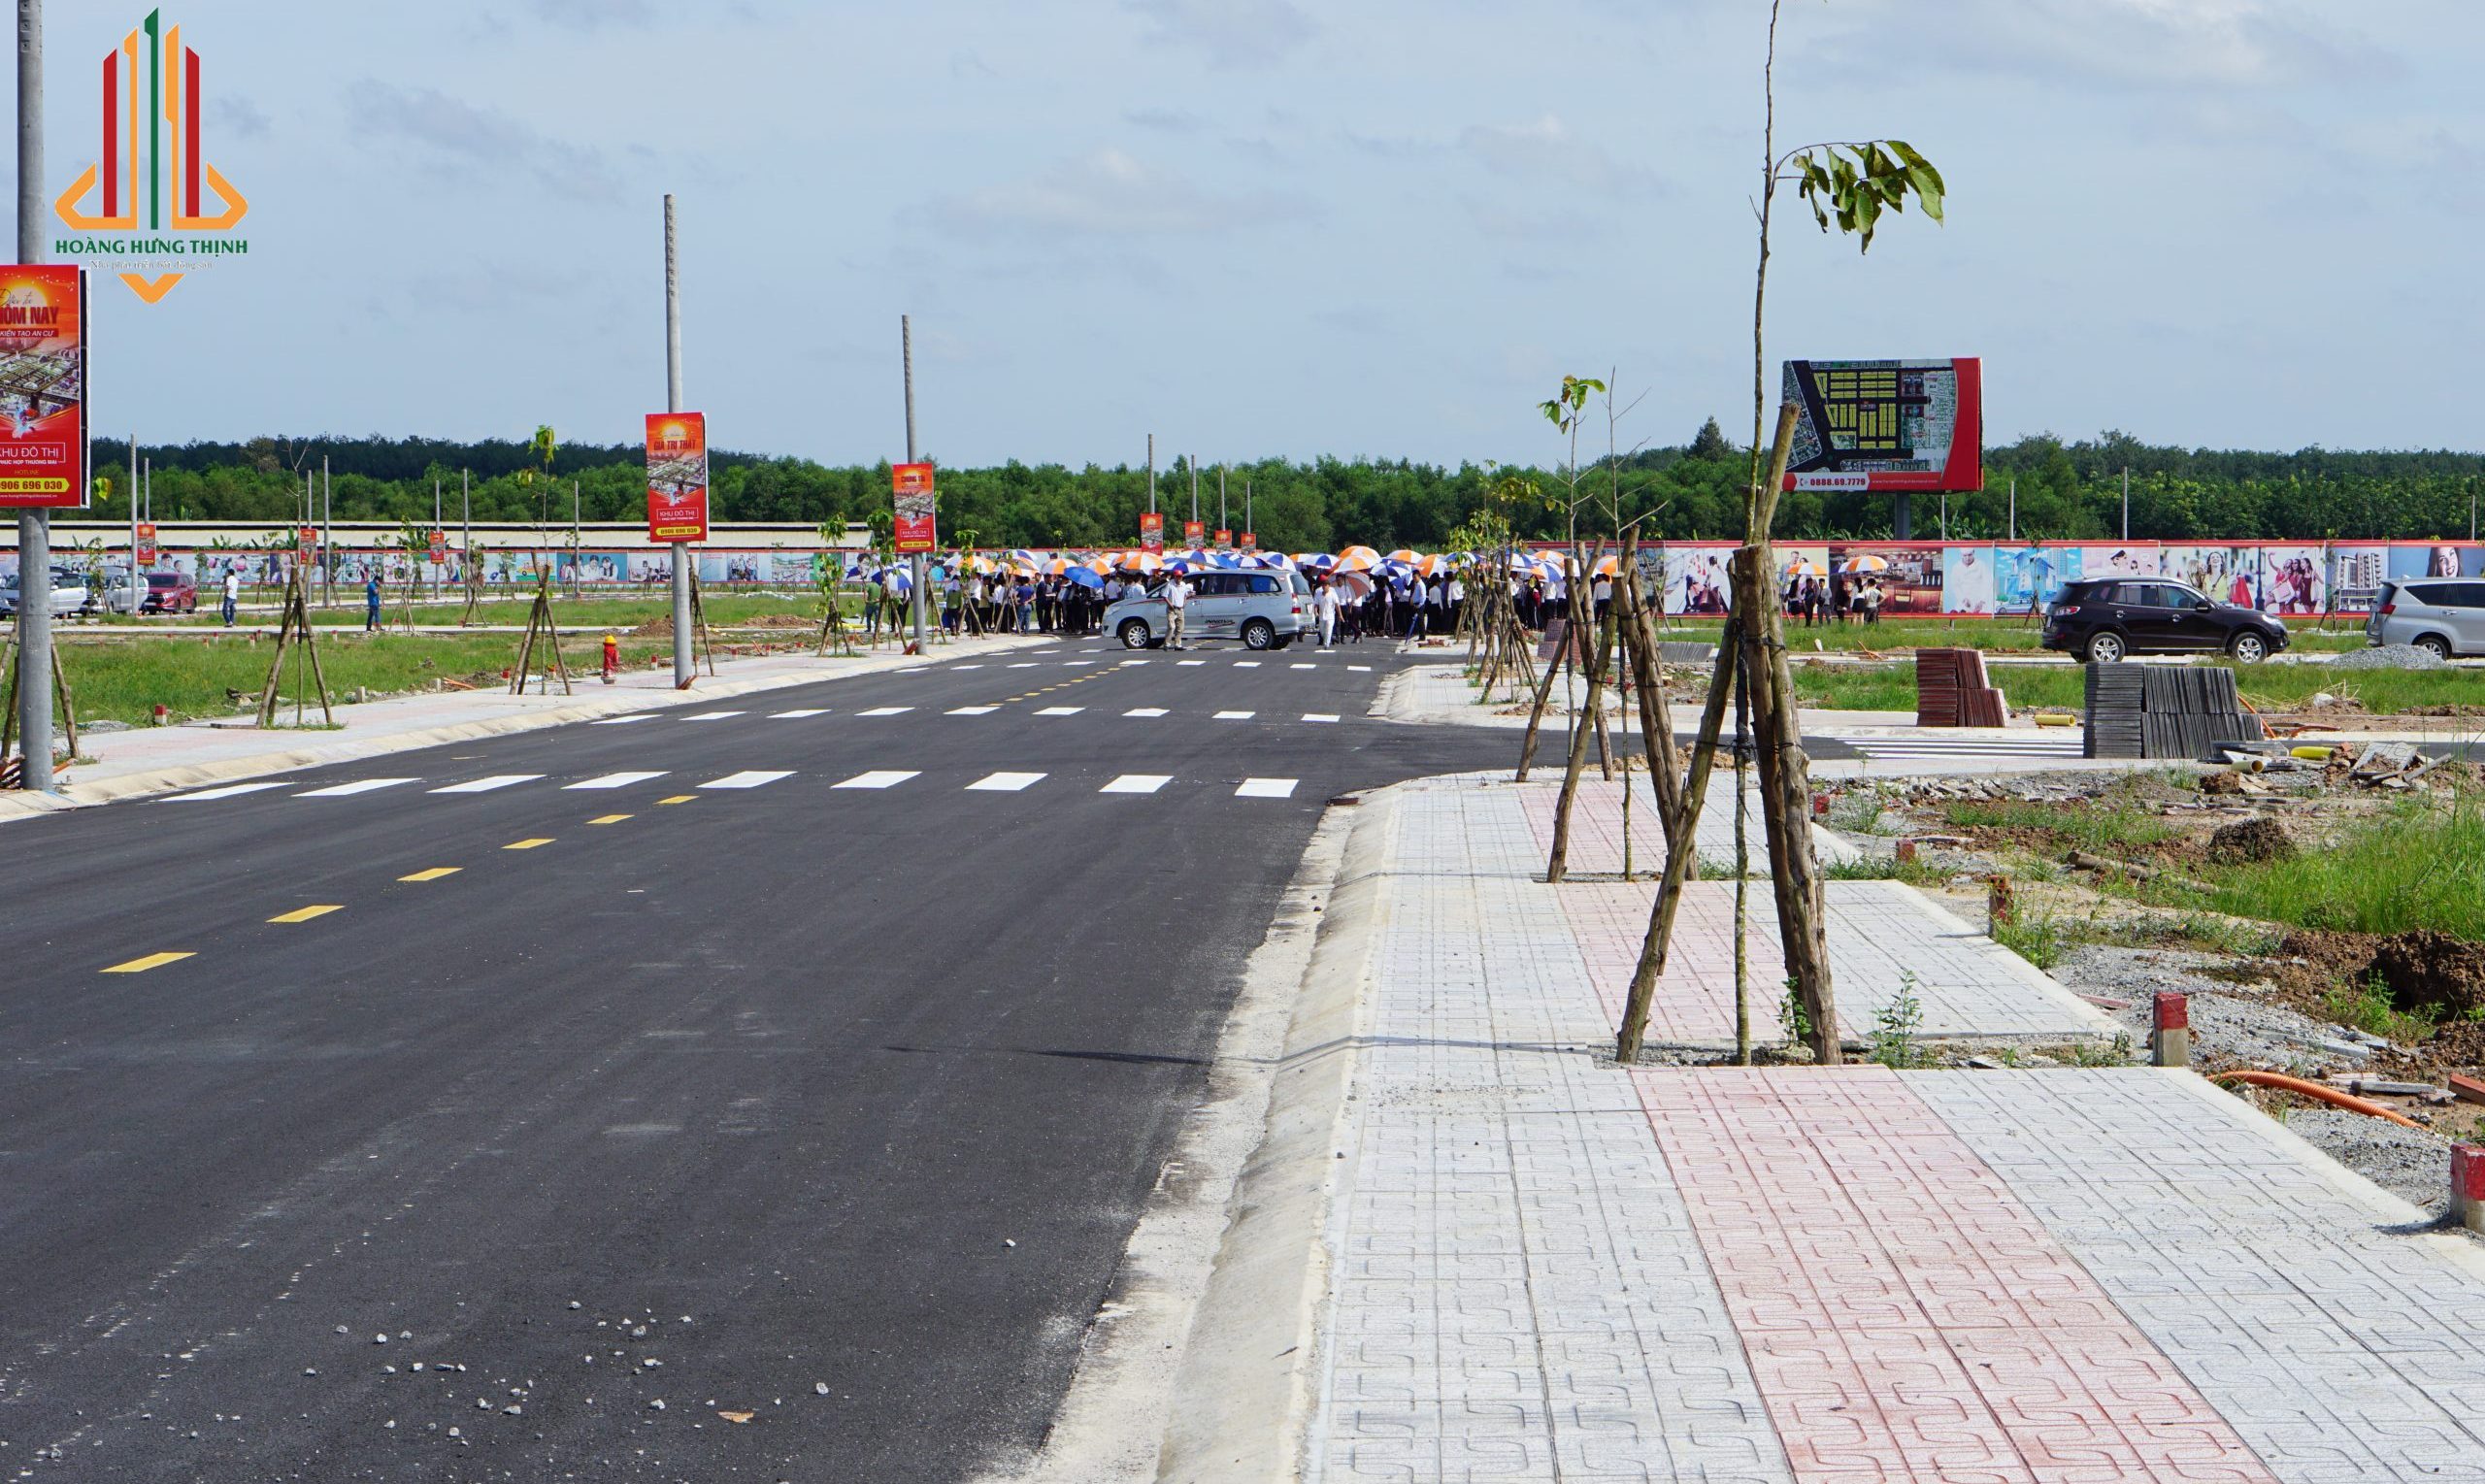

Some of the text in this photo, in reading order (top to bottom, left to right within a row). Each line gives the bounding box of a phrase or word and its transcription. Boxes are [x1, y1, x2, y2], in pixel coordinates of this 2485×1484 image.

[30, 306, 59, 324] NAY
[21, 445, 39, 457] ĐÔ
[41, 447, 59, 458] THỊ
[0, 480, 62, 489] 906 696 030
